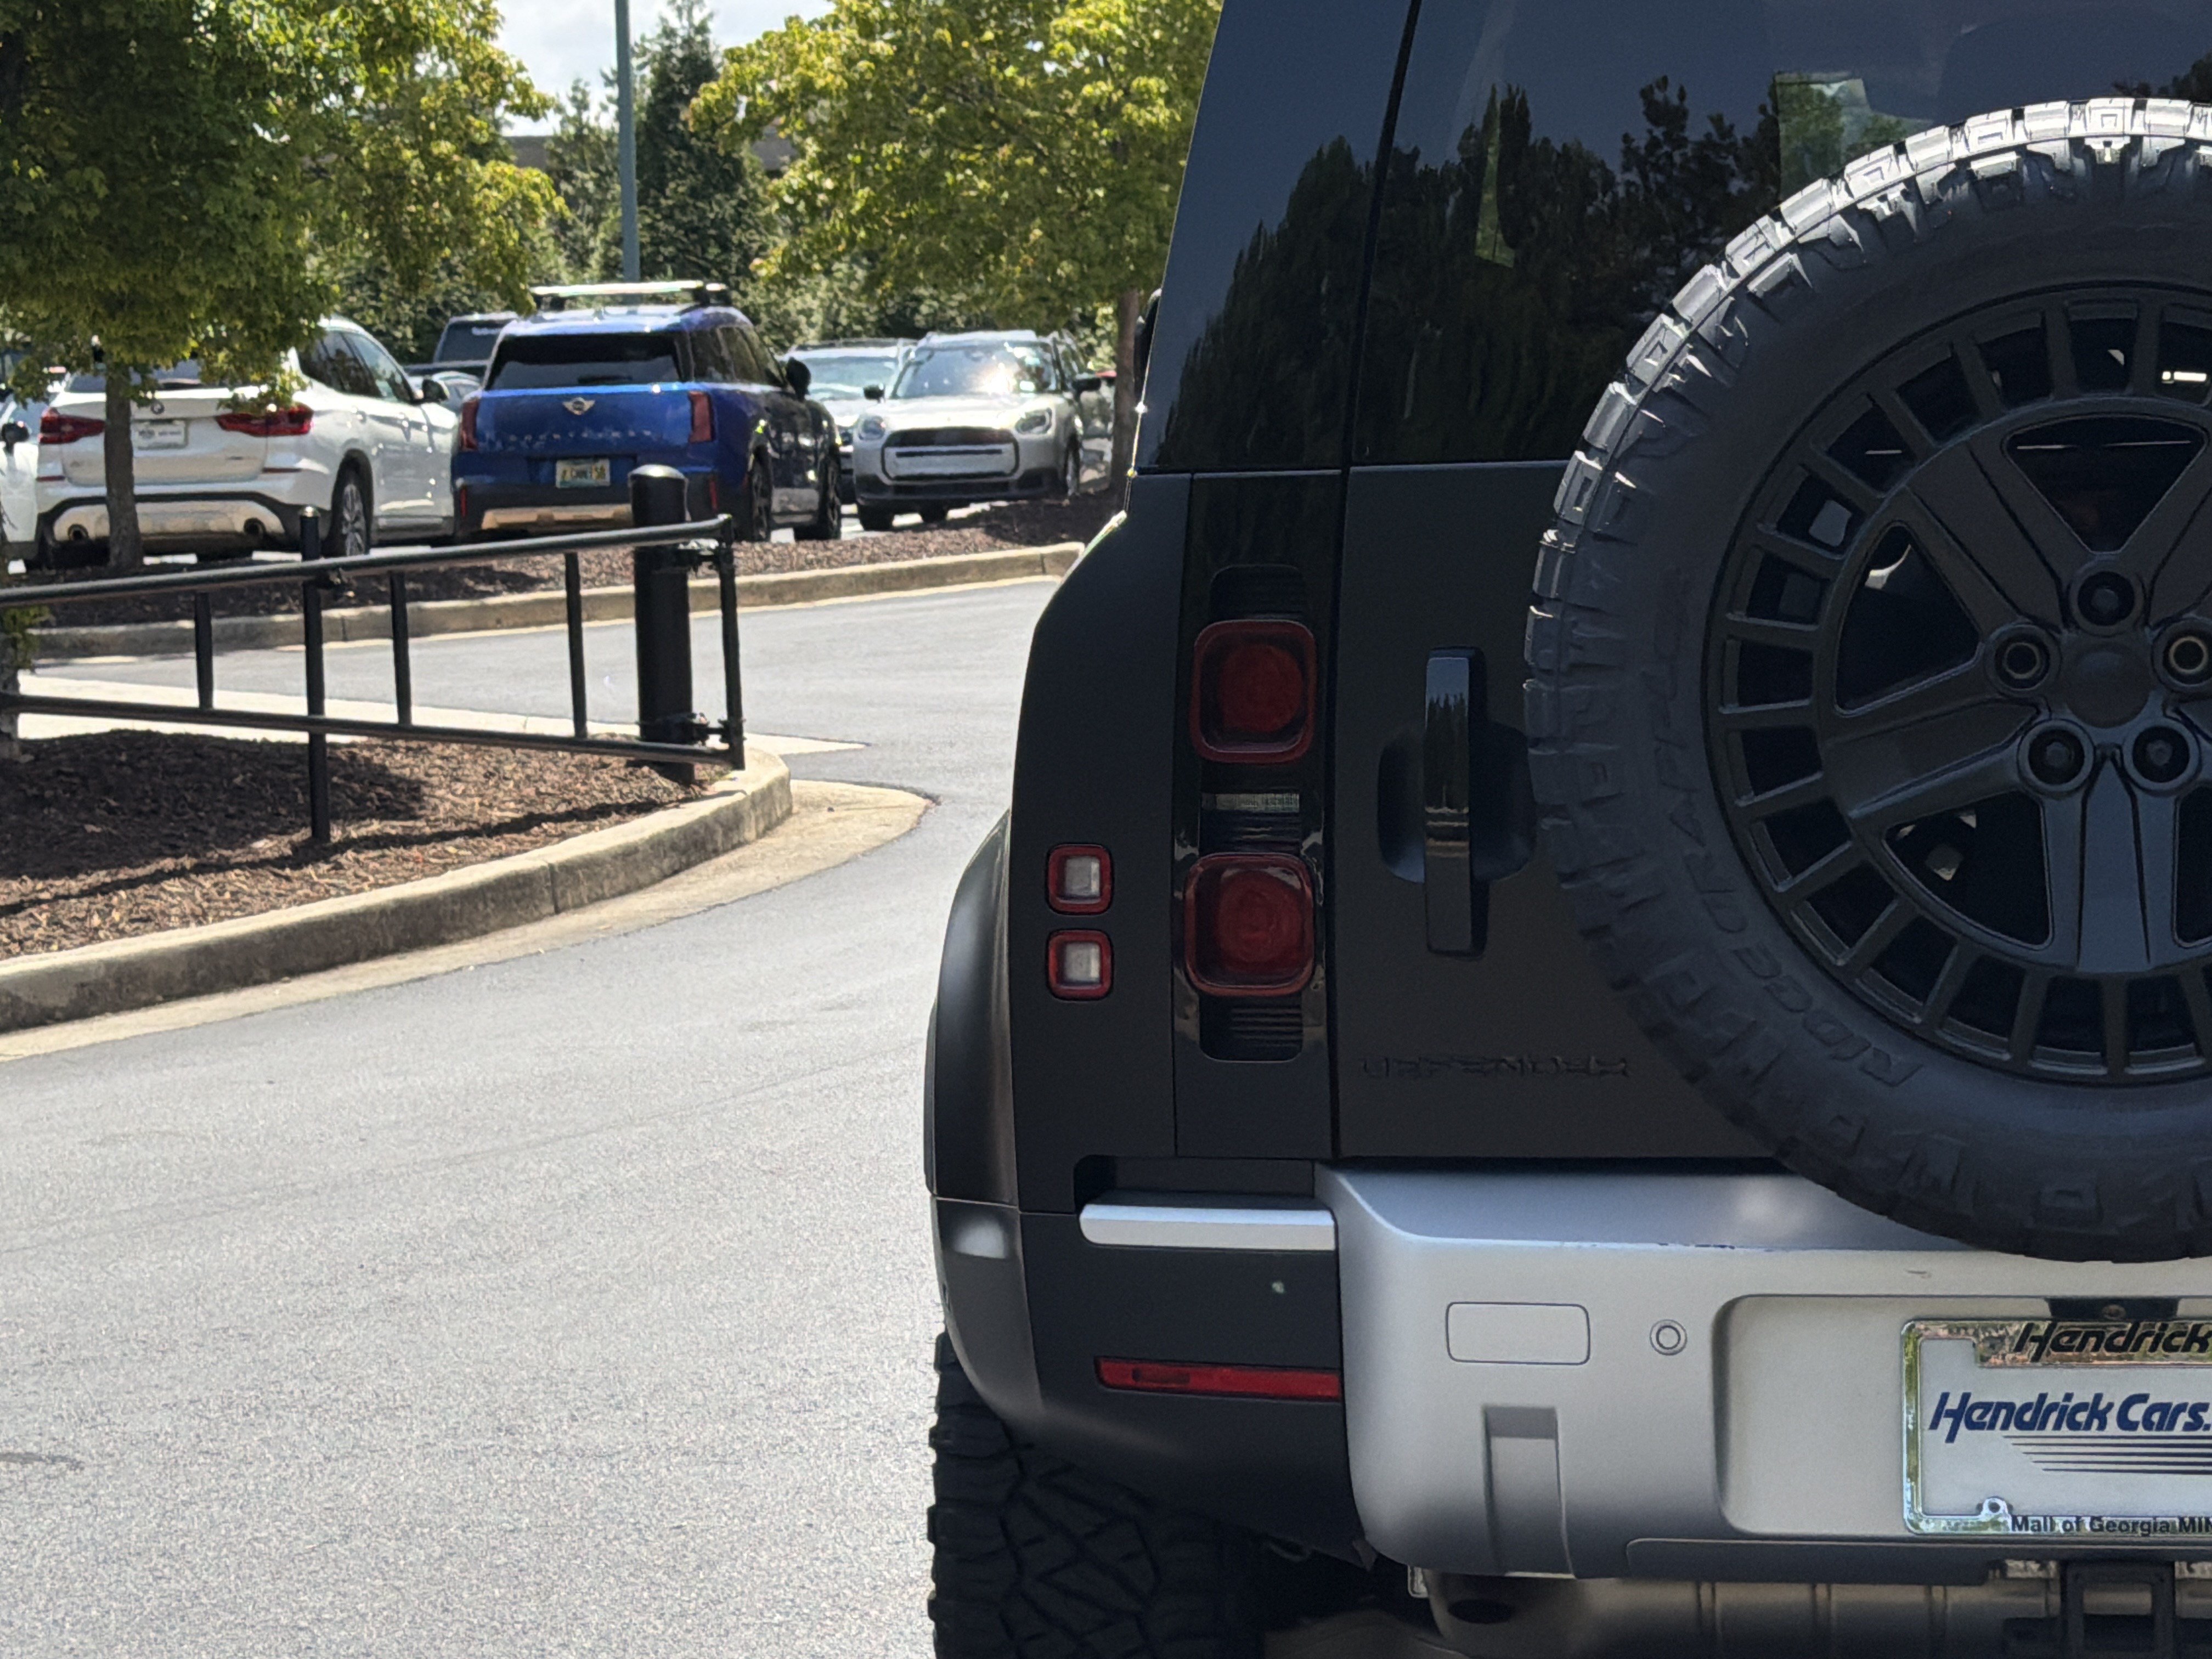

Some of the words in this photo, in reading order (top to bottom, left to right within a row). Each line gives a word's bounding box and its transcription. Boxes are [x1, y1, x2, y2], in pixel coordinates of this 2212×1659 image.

[2012, 1321, 2212, 1363] Hendrick
[2011, 1515, 2053, 1532] Mall
[2062, 1515, 2081, 1532] of
[2089, 1515, 2170, 1537] Georgia
